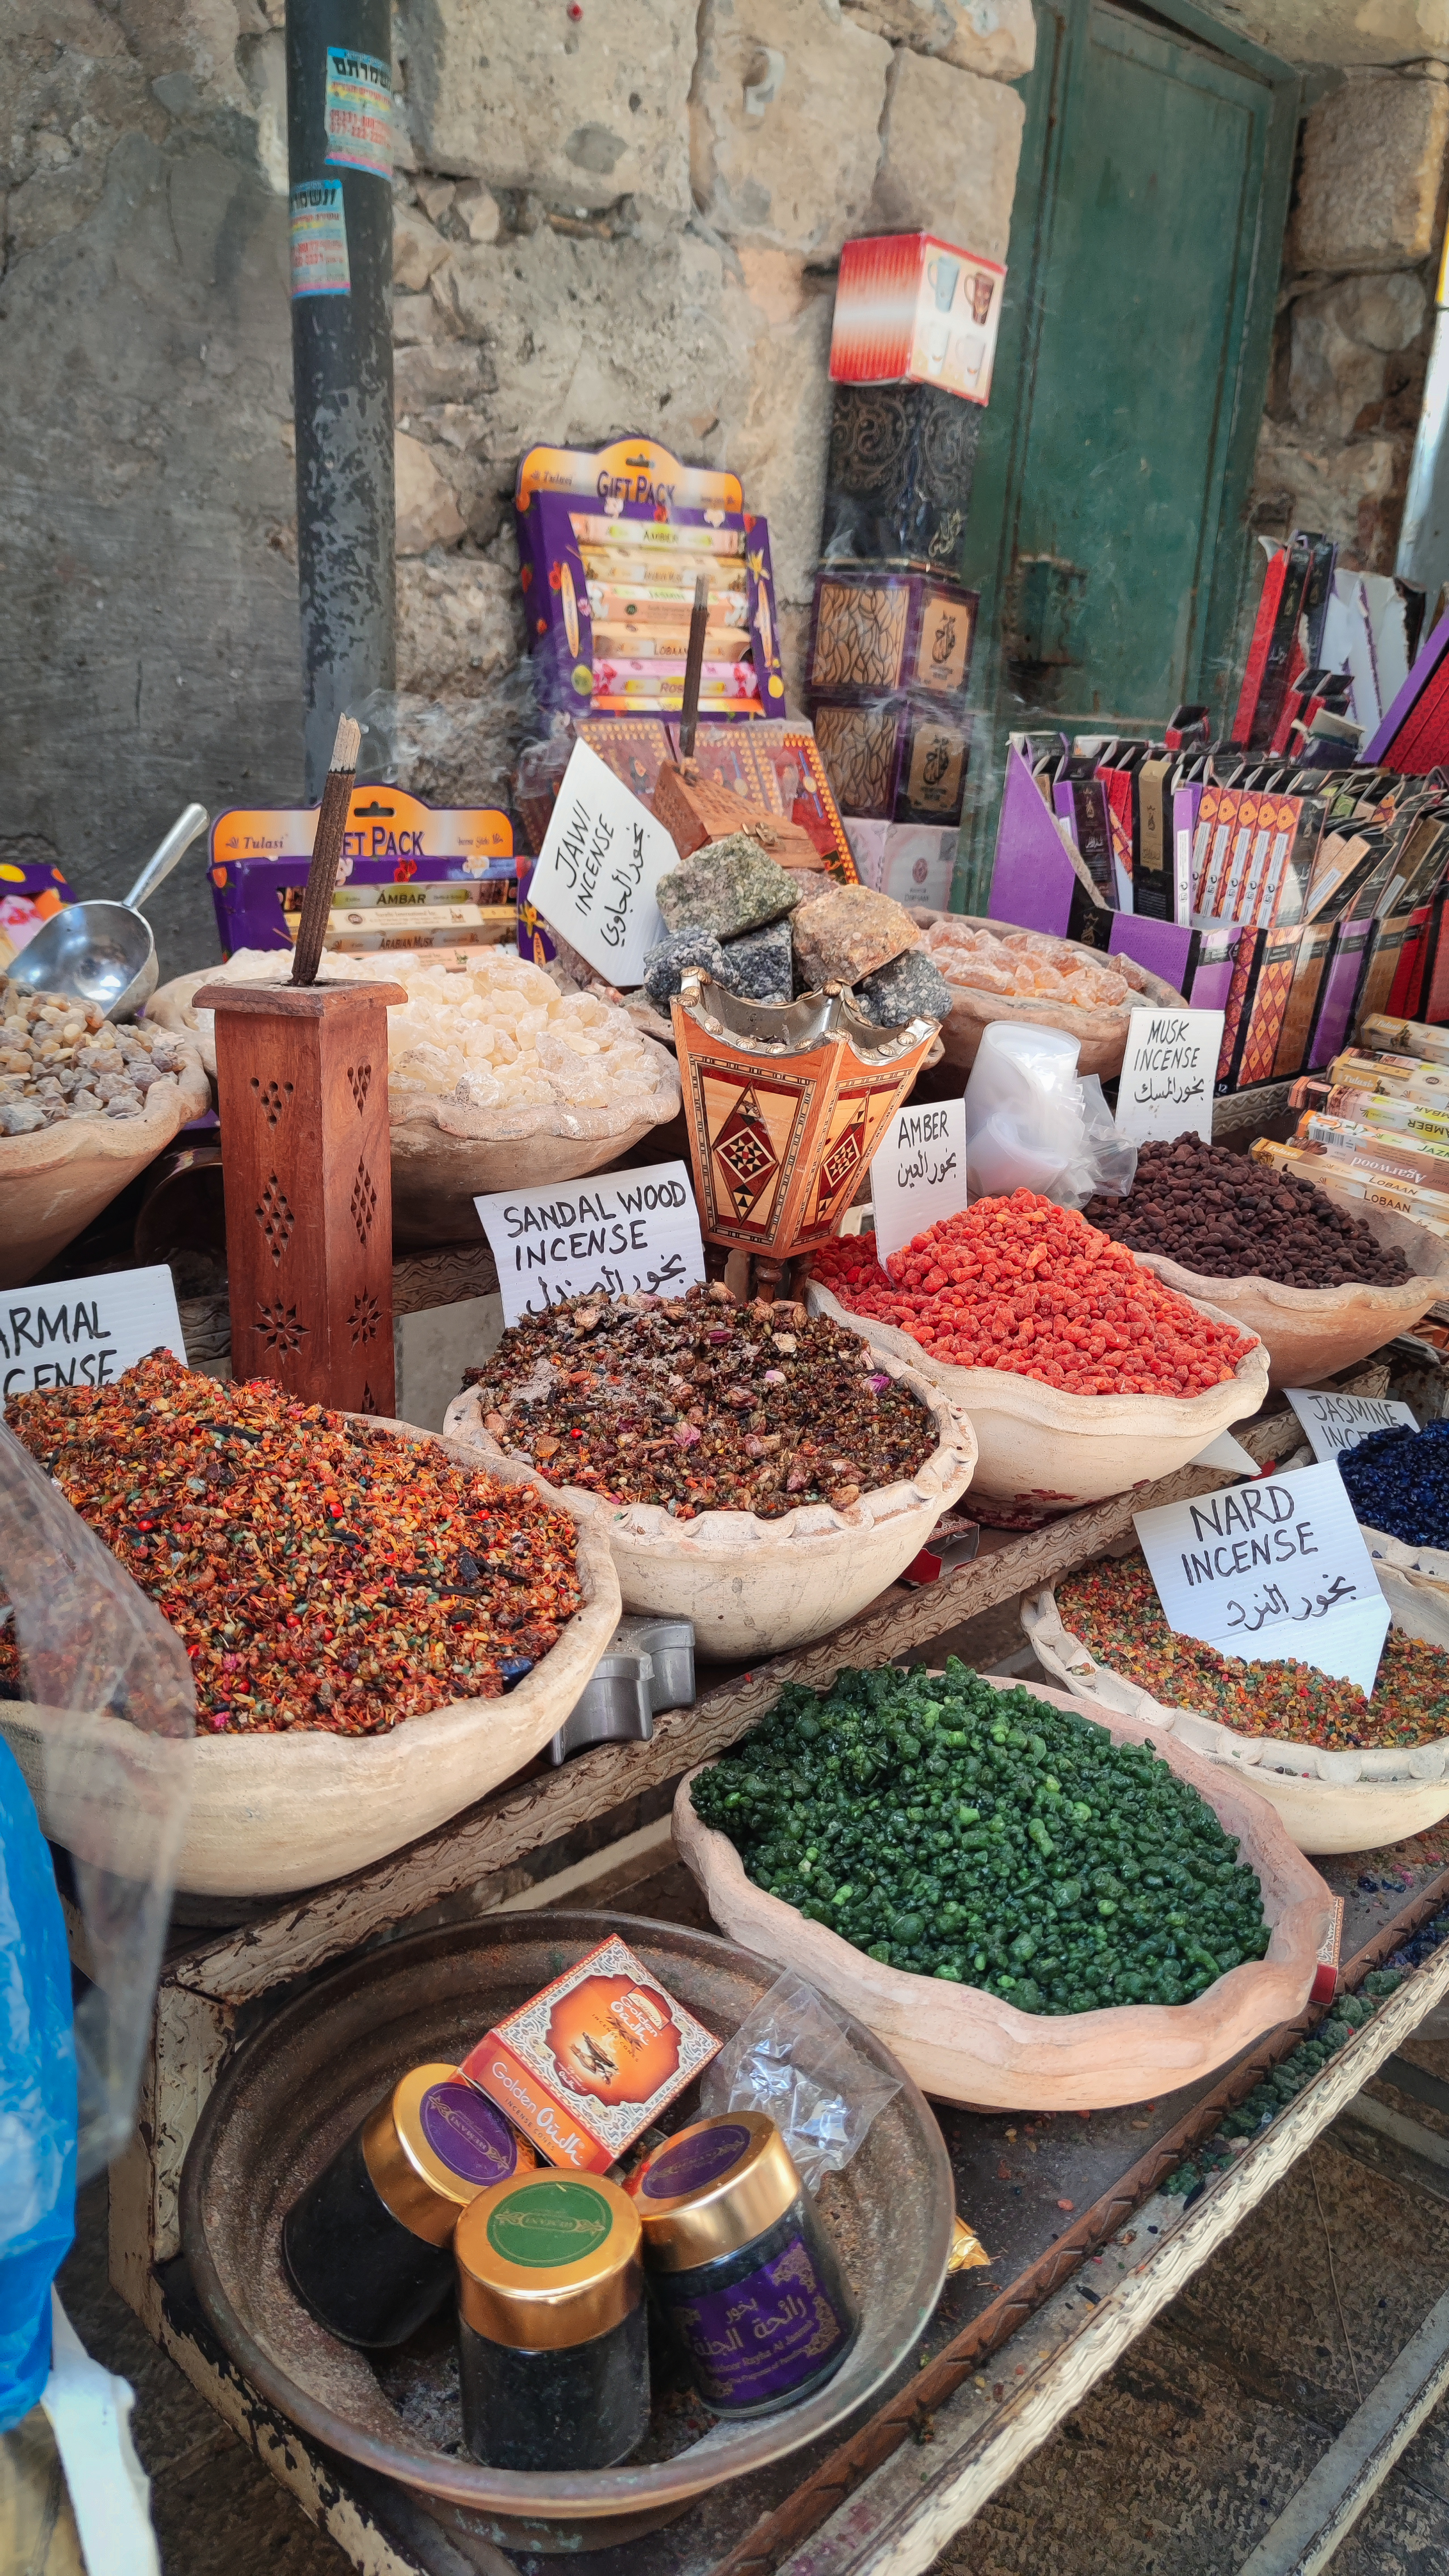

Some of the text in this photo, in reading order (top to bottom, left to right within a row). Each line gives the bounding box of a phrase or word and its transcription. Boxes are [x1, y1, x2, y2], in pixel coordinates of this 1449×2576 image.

[596, 470, 676, 507] GIFT PACK
[244, 836, 284, 850] Tulasi
[343, 826, 424, 856] FT PACK
[555, 799, 591, 889] JAWI
[575, 813, 614, 916] INCENSE
[376, 890, 427, 905] AMBAR
[1147, 1019, 1190, 1046] MUSK
[1133, 1046, 1200, 1072] INCENSE
[898, 1110, 949, 1149] AMBER
[1350, 1157, 1428, 1184] Agarwood
[1368, 1176, 1418, 1196] LOBAAN
[1364, 1190, 1411, 1213] LOBAAN
[516, 1220, 648, 1271] INCENSE
[1307, 1394, 1400, 1427] JASMINE
[1189, 1485, 1295, 1542] NARD
[1181, 1521, 1319, 1586] INCENSE
[620, 1996, 659, 2038] Golden
[492, 2061, 537, 2114] Golden
[504, 2097, 555, 2152] INCENSE CONES
[692, 2294, 808, 2356] رائحة الجنة
[726, 2297, 758, 2325] بخور
